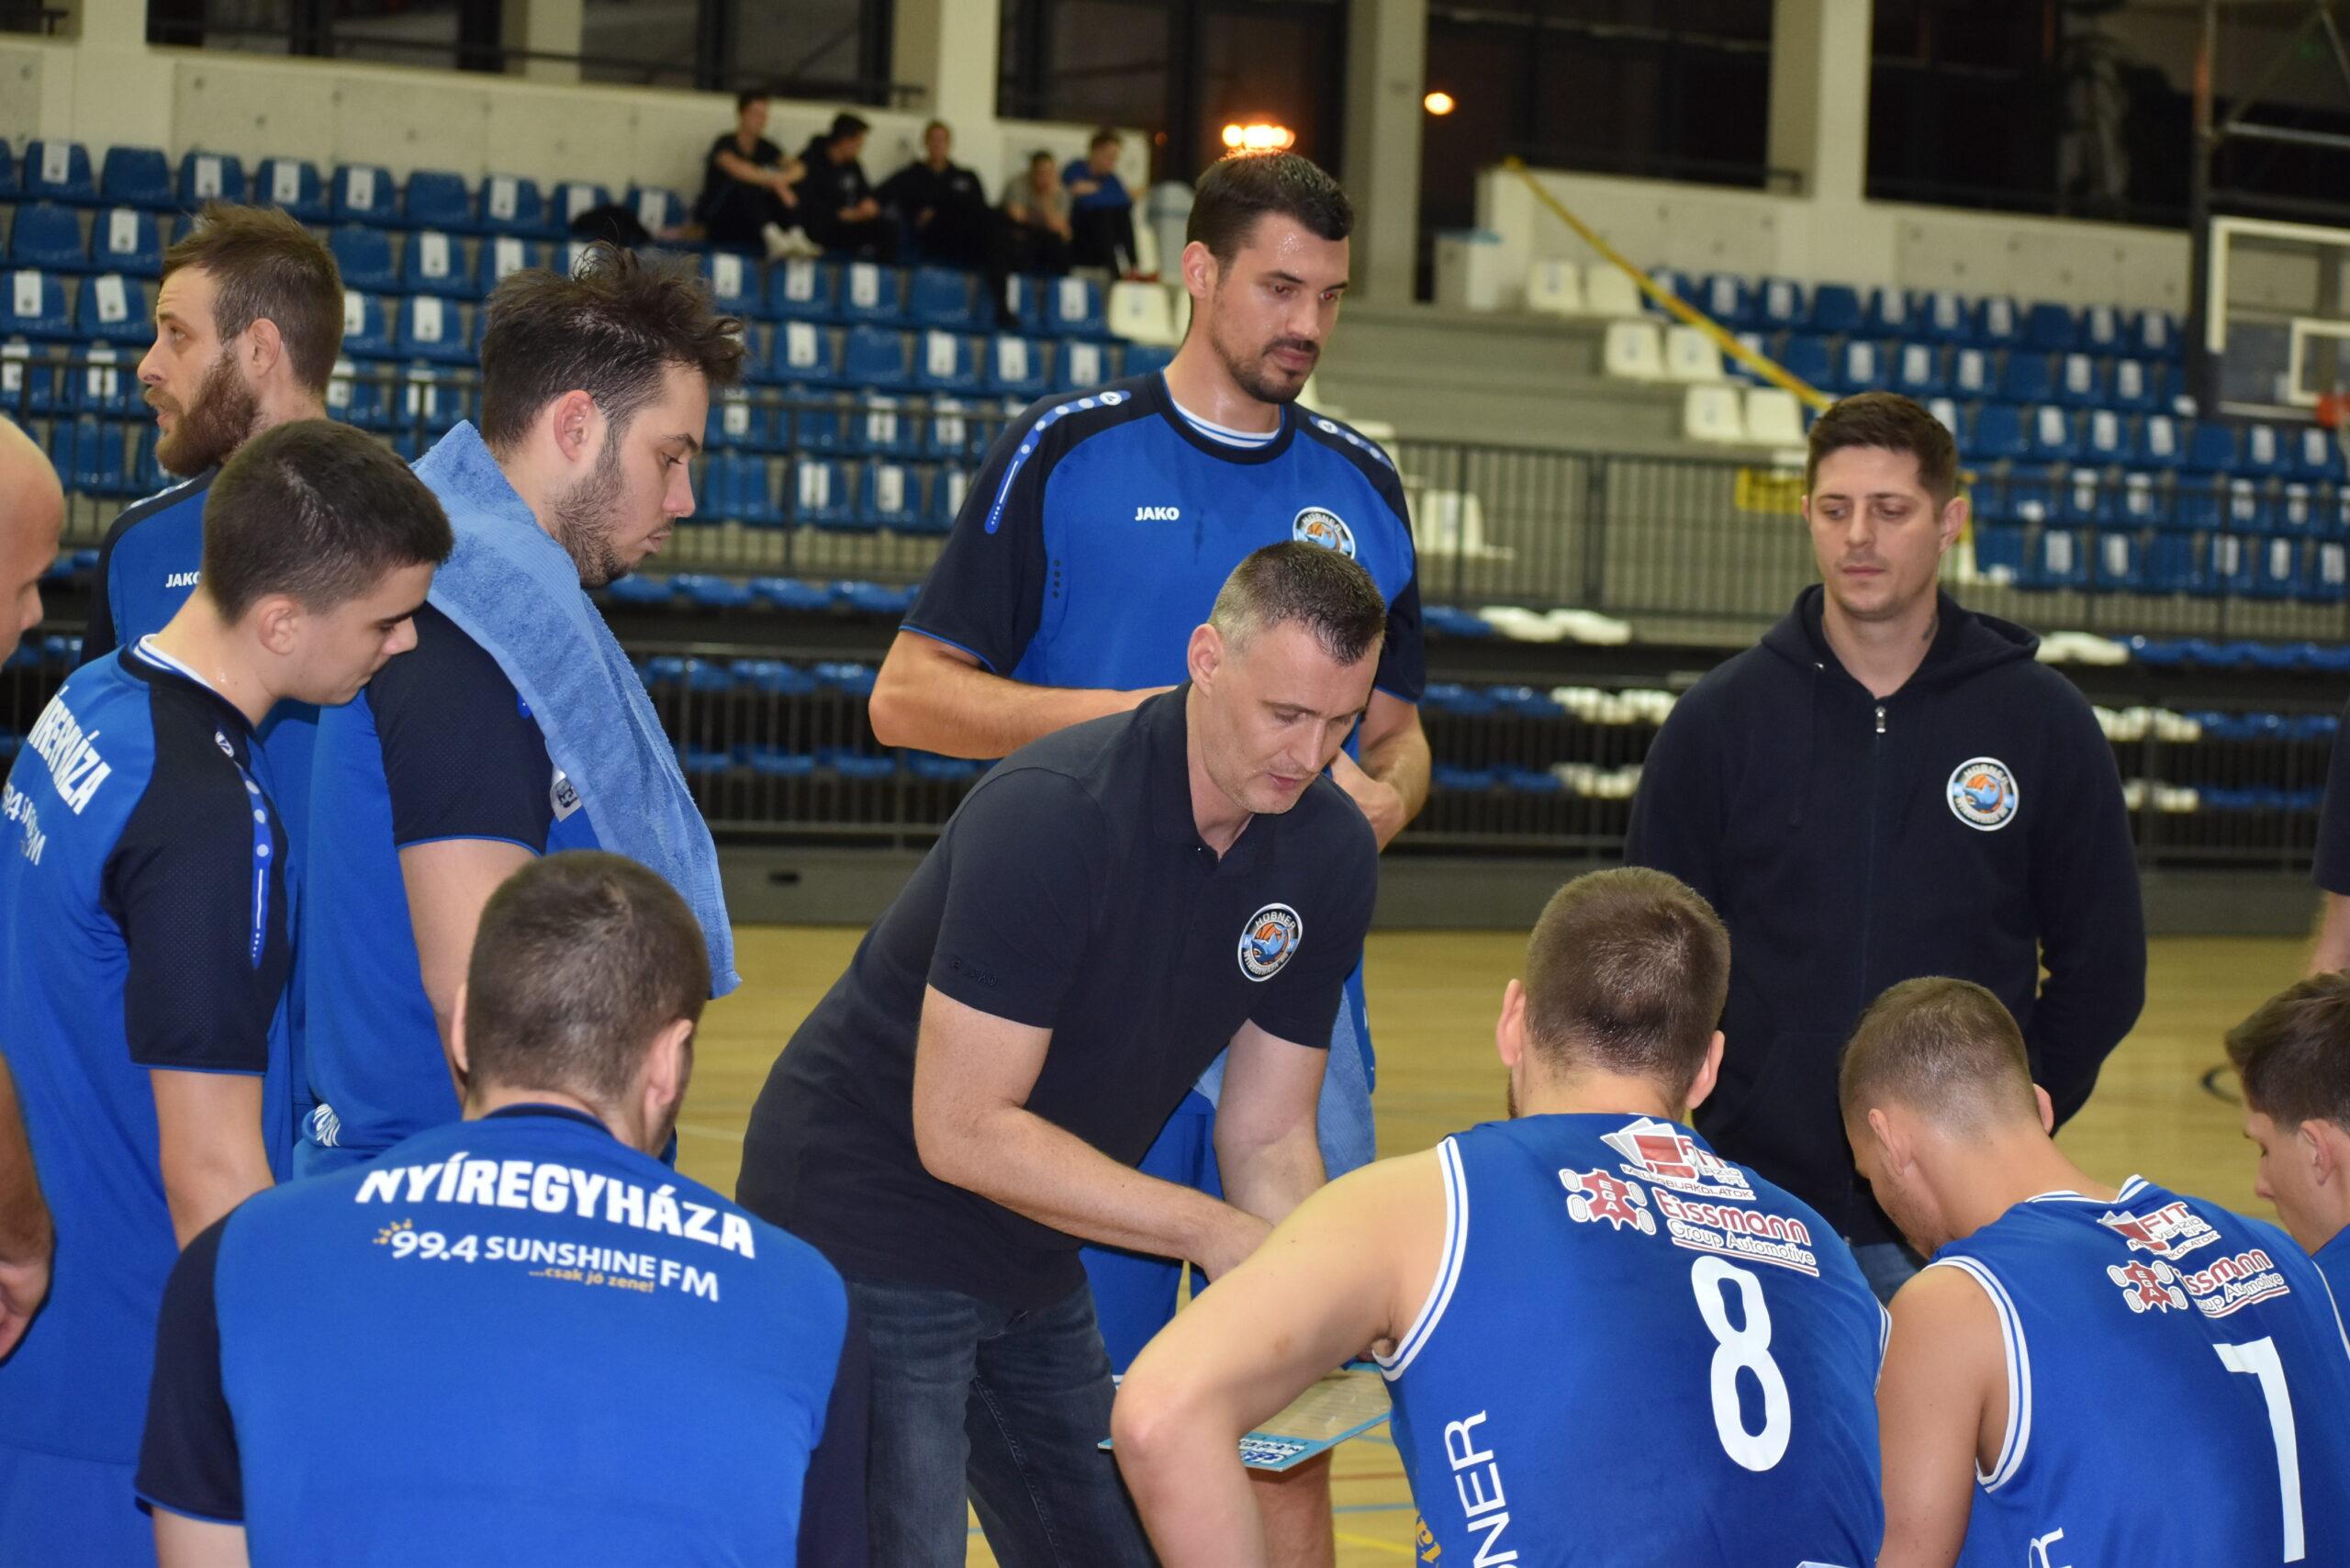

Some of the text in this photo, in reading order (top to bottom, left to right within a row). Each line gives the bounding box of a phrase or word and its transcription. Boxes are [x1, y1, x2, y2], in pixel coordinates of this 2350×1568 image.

[1135, 507, 1180, 521] JAKO
[354, 1151, 755, 1260] NYÍREGYHÁZA
[1654, 1188, 1810, 1245] Eissmann
[2139, 1203, 2188, 1235] FIT
[391, 1230, 719, 1302] 99.4 SUNSHINE FM
[1669, 1220, 1816, 1265] Group Automotive
[1692, 1256, 1791, 1472] 8
[2212, 1336, 2305, 1562] 7
[1445, 1410, 1518, 1568] NER
